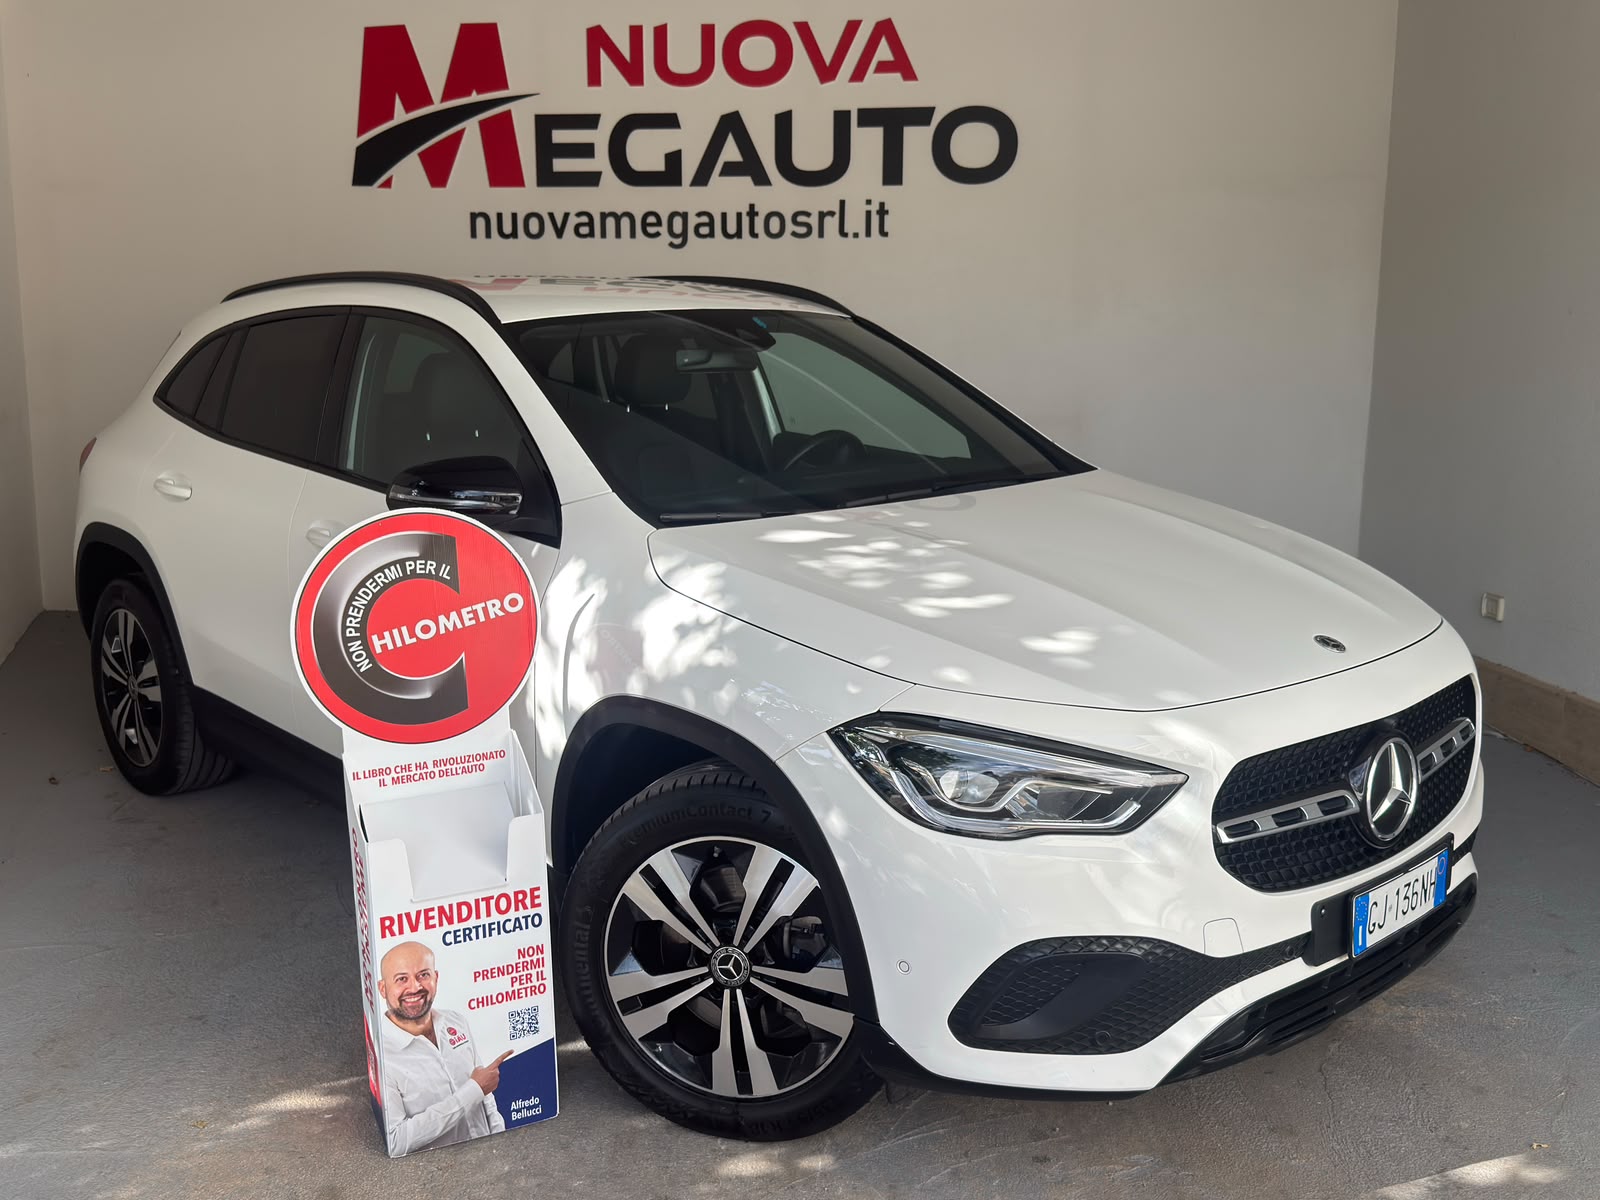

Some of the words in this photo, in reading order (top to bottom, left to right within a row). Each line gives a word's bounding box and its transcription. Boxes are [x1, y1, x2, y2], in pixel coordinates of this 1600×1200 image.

[586, 17, 919, 88] NUOVA
[351, 22, 1019, 189] MEGAUTO
[469, 199, 890, 250] nuovamegautosrl.it
[406, 560, 436, 575] PER
[439, 564, 452, 580] IL
[346, 564, 403, 638] PRENDERMI
[348, 641, 372, 672] NON
[352, 771, 361, 781] IL
[363, 766, 391, 780] LIBRO
[394, 764, 413, 774] CHE
[415, 761, 429, 771] HA
[433, 749, 506, 770] RIVOLUZIONATO
[378, 778, 388, 788] IL
[391, 770, 436, 786] MERCATO
[379, 886, 542, 939] RIVENDITORE
[442, 913, 543, 946] CERTIFICATO
[517, 944, 544, 960] NON
[473, 957, 545, 983] PRENDERMI
[510, 973, 533, 988] PER
[536, 971, 546, 982] IL
[468, 983, 547, 1010] CHILOMETRO
[510, 1096, 540, 1111] Alfredo
[511, 1105, 542, 1121] Bellucci
